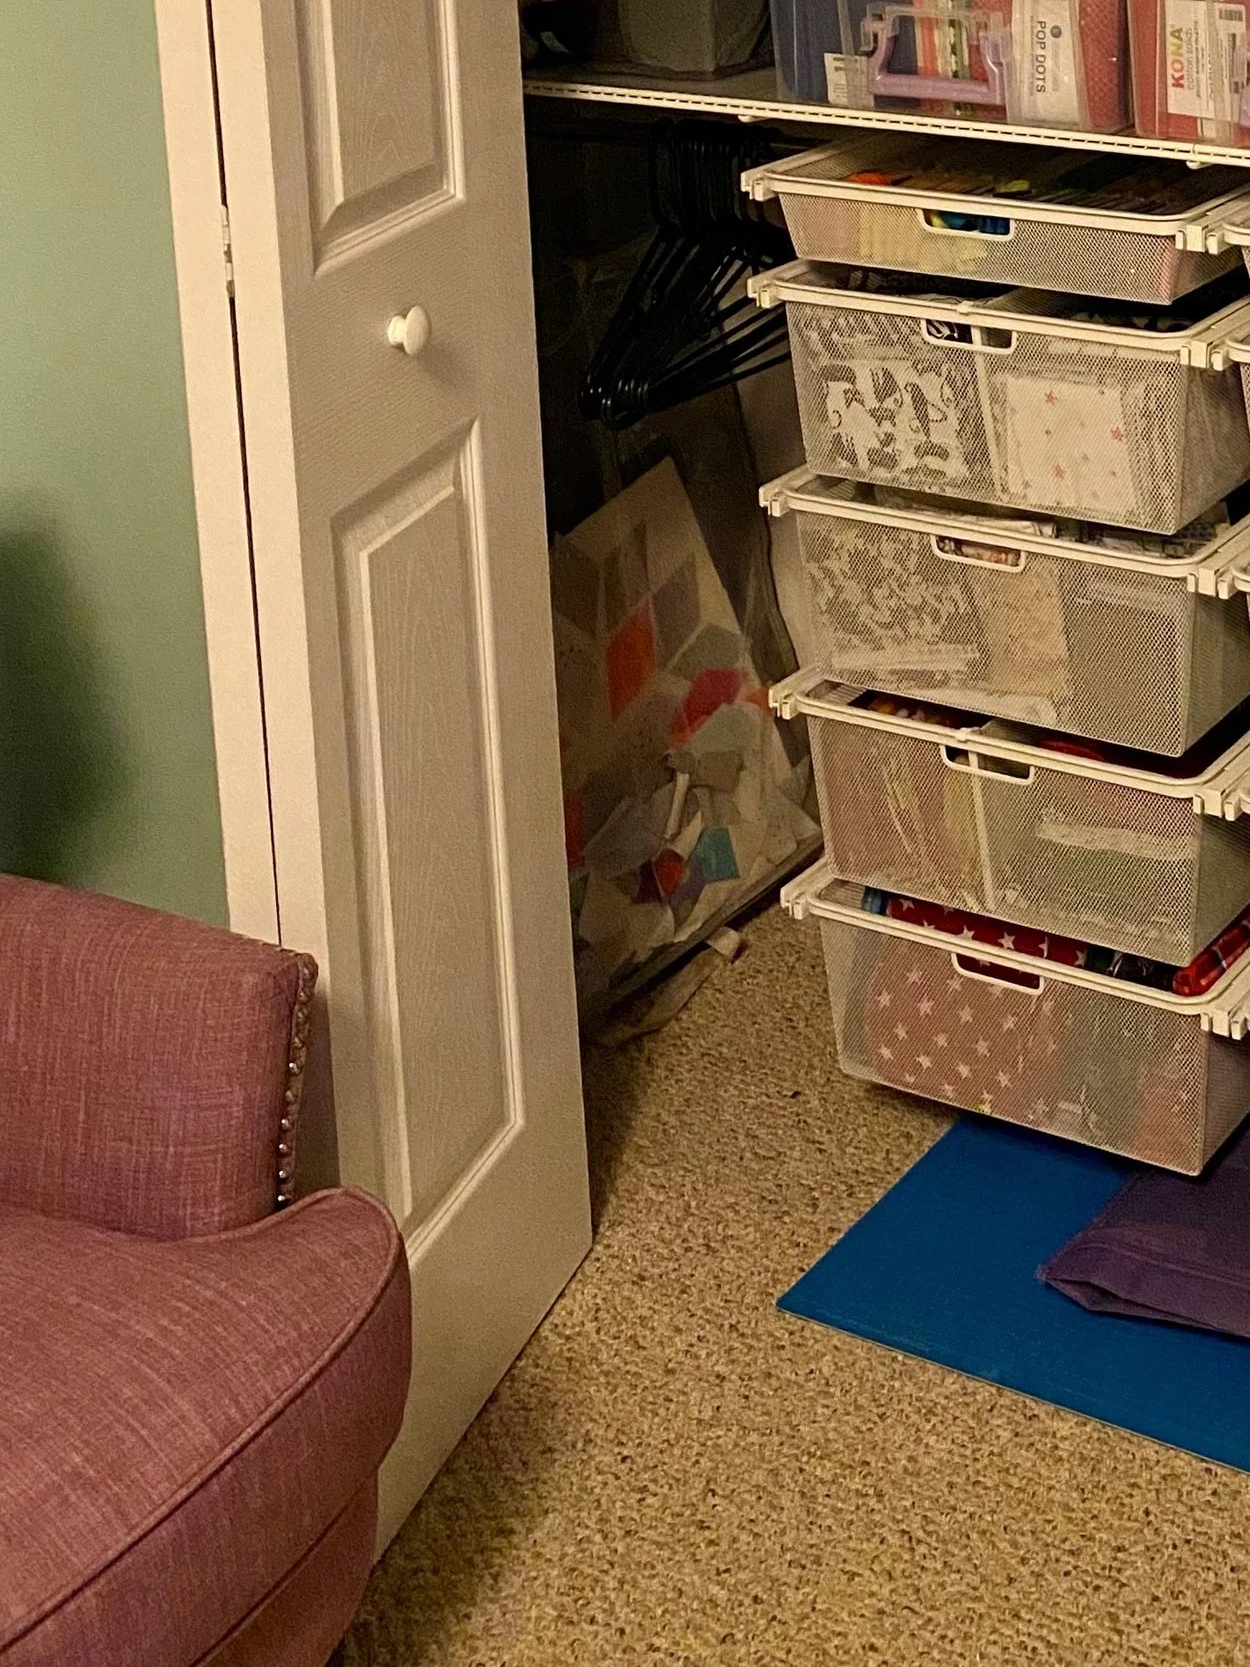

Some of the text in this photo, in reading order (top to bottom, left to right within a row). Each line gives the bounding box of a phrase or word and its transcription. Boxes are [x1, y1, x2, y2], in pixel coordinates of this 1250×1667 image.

[1035, 20, 1047, 93] POP DOTS
[1169, 27, 1185, 89] KONA
[1185, 56, 1194, 91] cotton
